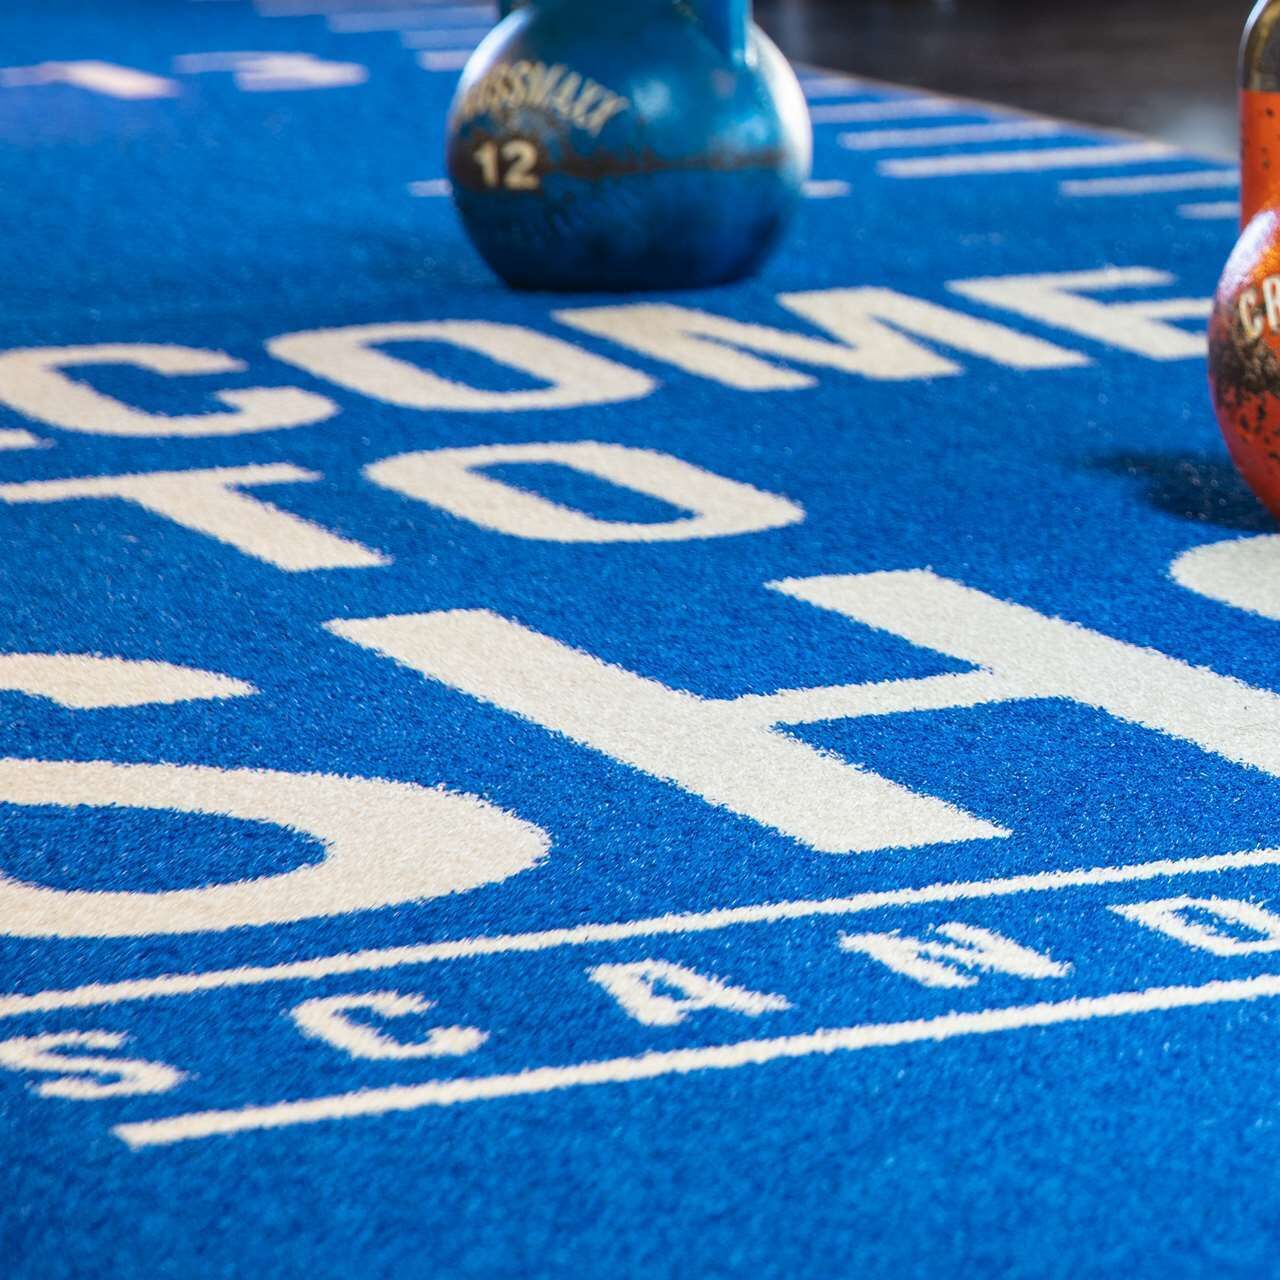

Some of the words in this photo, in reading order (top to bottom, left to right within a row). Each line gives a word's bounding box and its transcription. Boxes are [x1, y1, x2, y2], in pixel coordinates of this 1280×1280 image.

[474, 139, 540, 190] 12
[0, 265, 1215, 450] COME
[0, 440, 806, 571] TO
